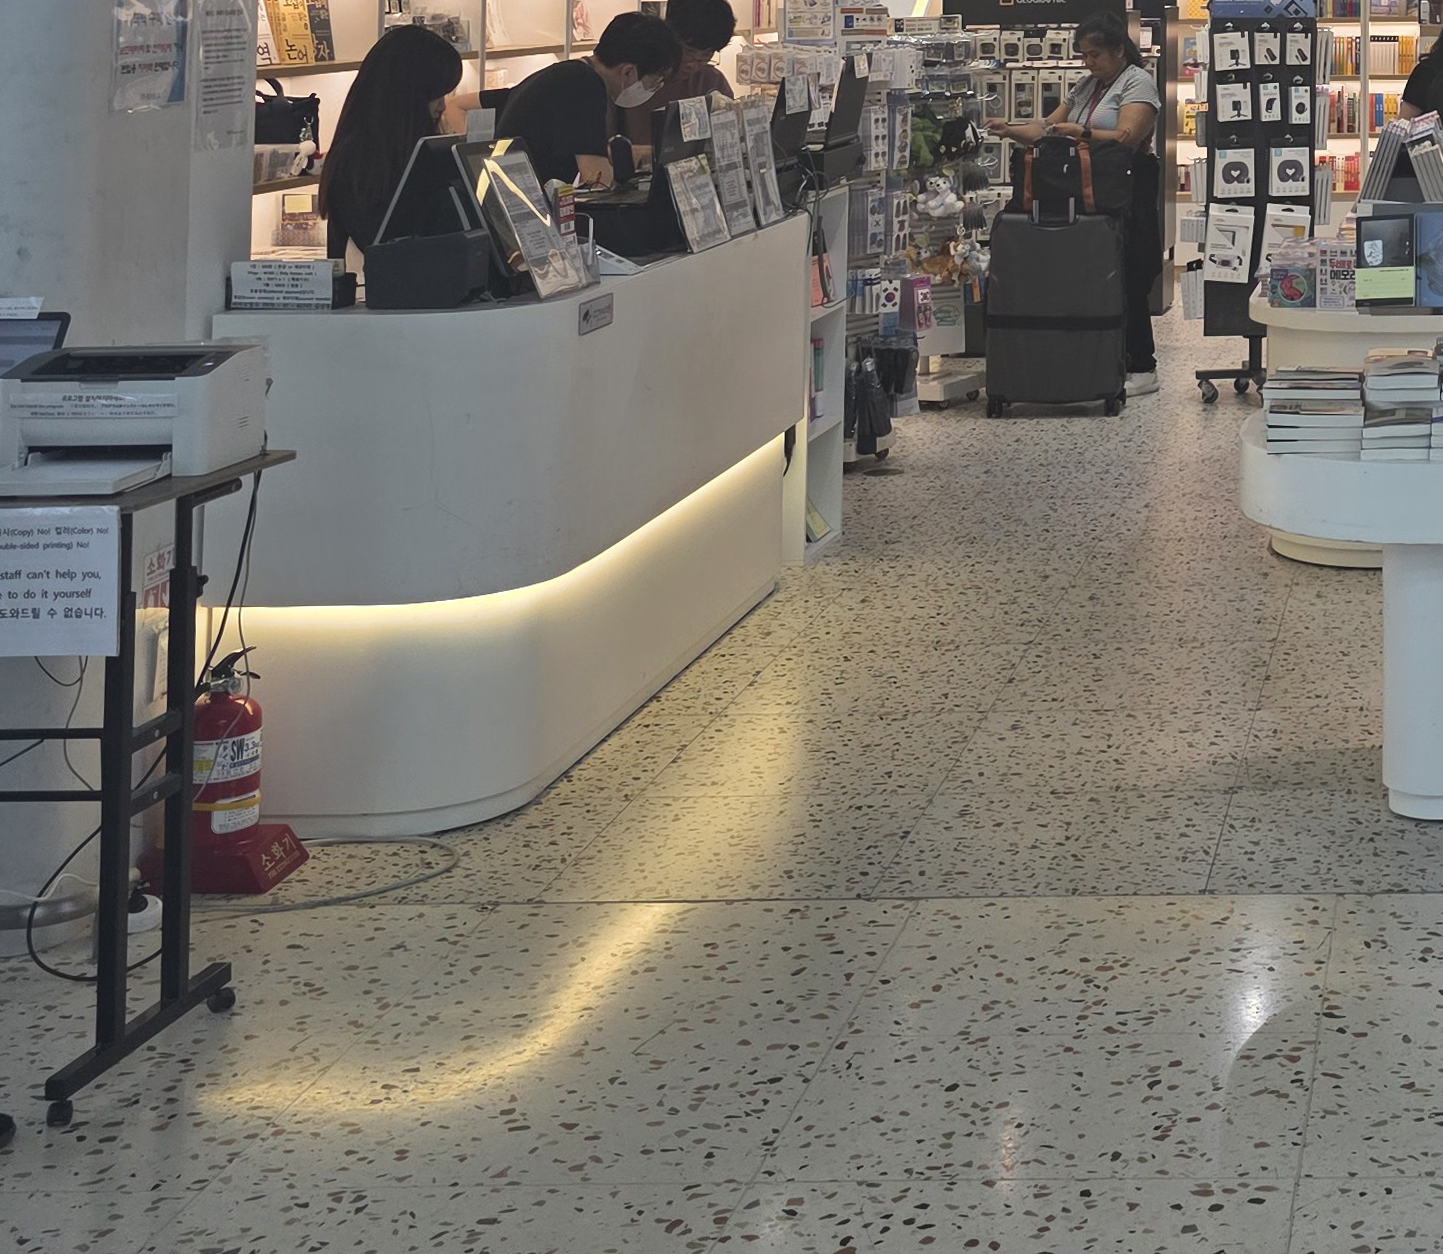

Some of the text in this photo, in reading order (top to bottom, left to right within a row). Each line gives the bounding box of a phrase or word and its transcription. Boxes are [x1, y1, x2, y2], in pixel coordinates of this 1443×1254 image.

[285, 39, 309, 64] 논어
[0, 527, 34, 538] 사(Copy)
[0, 569, 102, 582] staff can't help you,
[8, 588, 93, 602] to do it yourself
[0, 606, 107, 620] 도와드릴 수 없습니다.
[261, 832, 298, 872] 소화기
